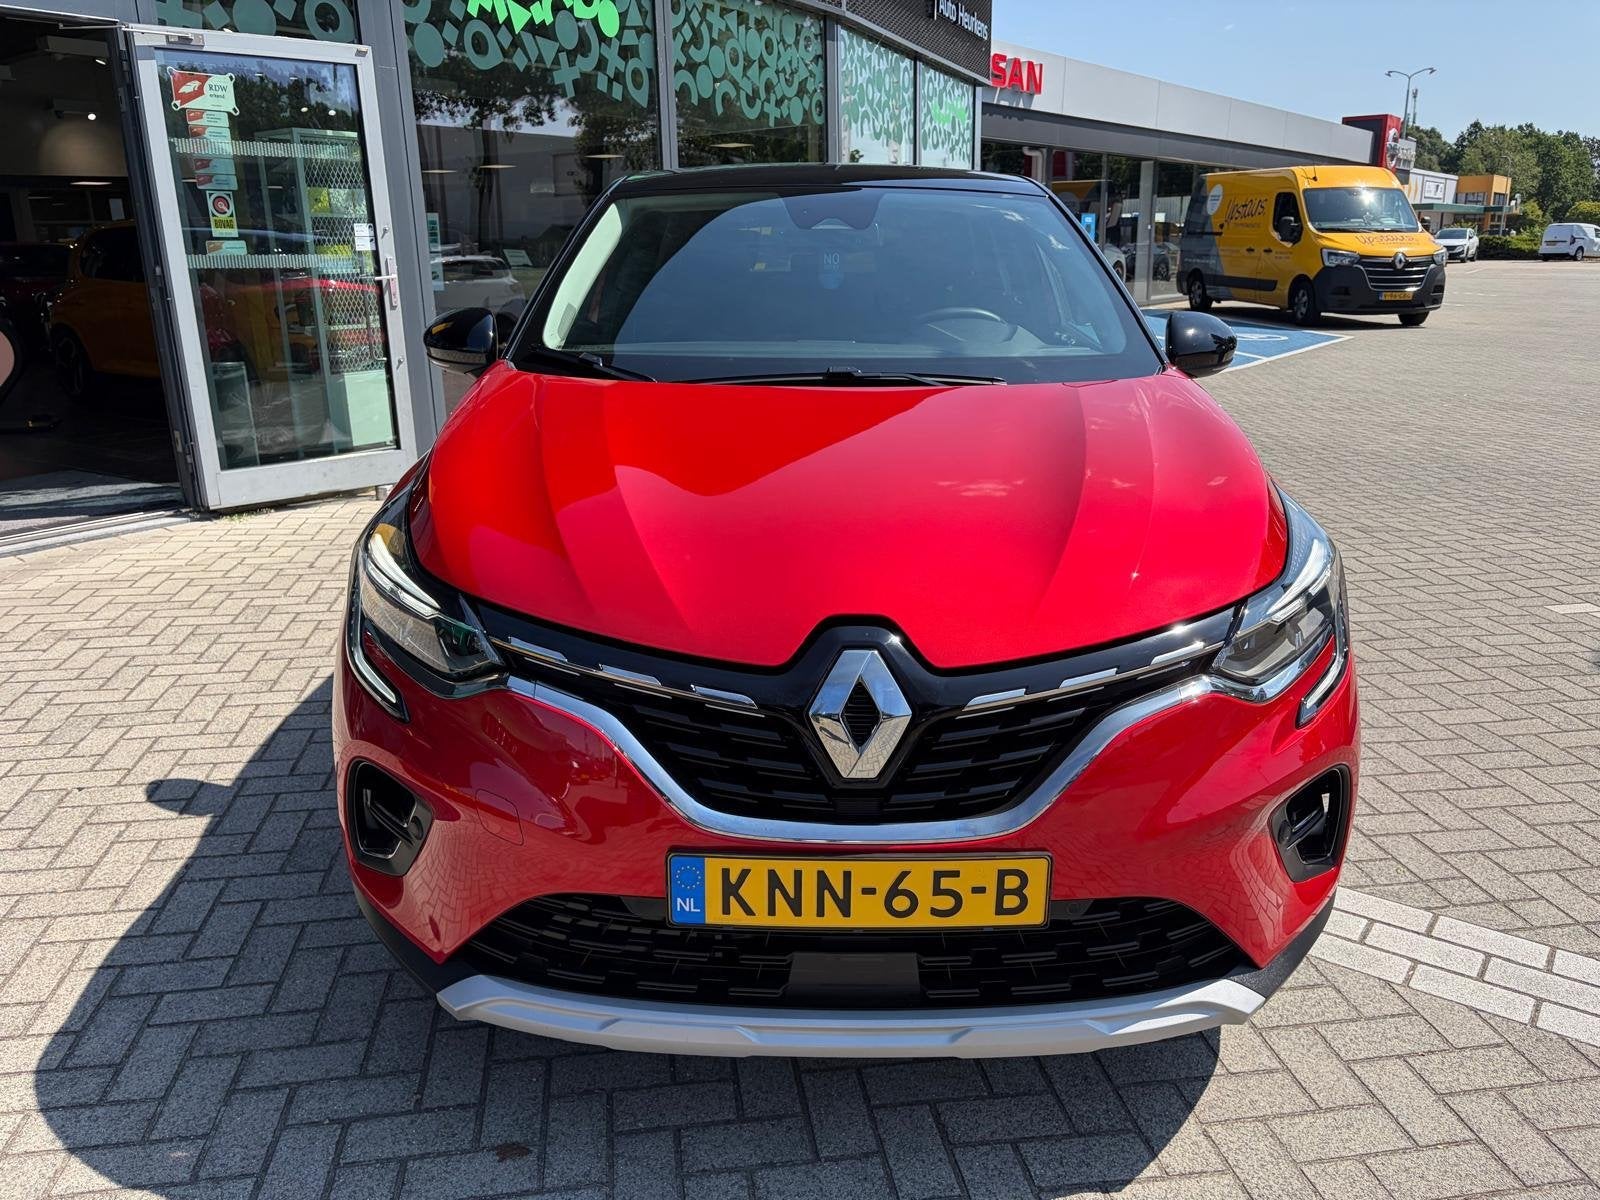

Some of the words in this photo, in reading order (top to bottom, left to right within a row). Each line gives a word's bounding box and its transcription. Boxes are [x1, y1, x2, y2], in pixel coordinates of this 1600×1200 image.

[958, 3, 989, 40] Heurkens
[208, 83, 228, 93] RDW
[676, 897, 701, 913] NL
[721, 867, 1030, 919] KNN-65-B
